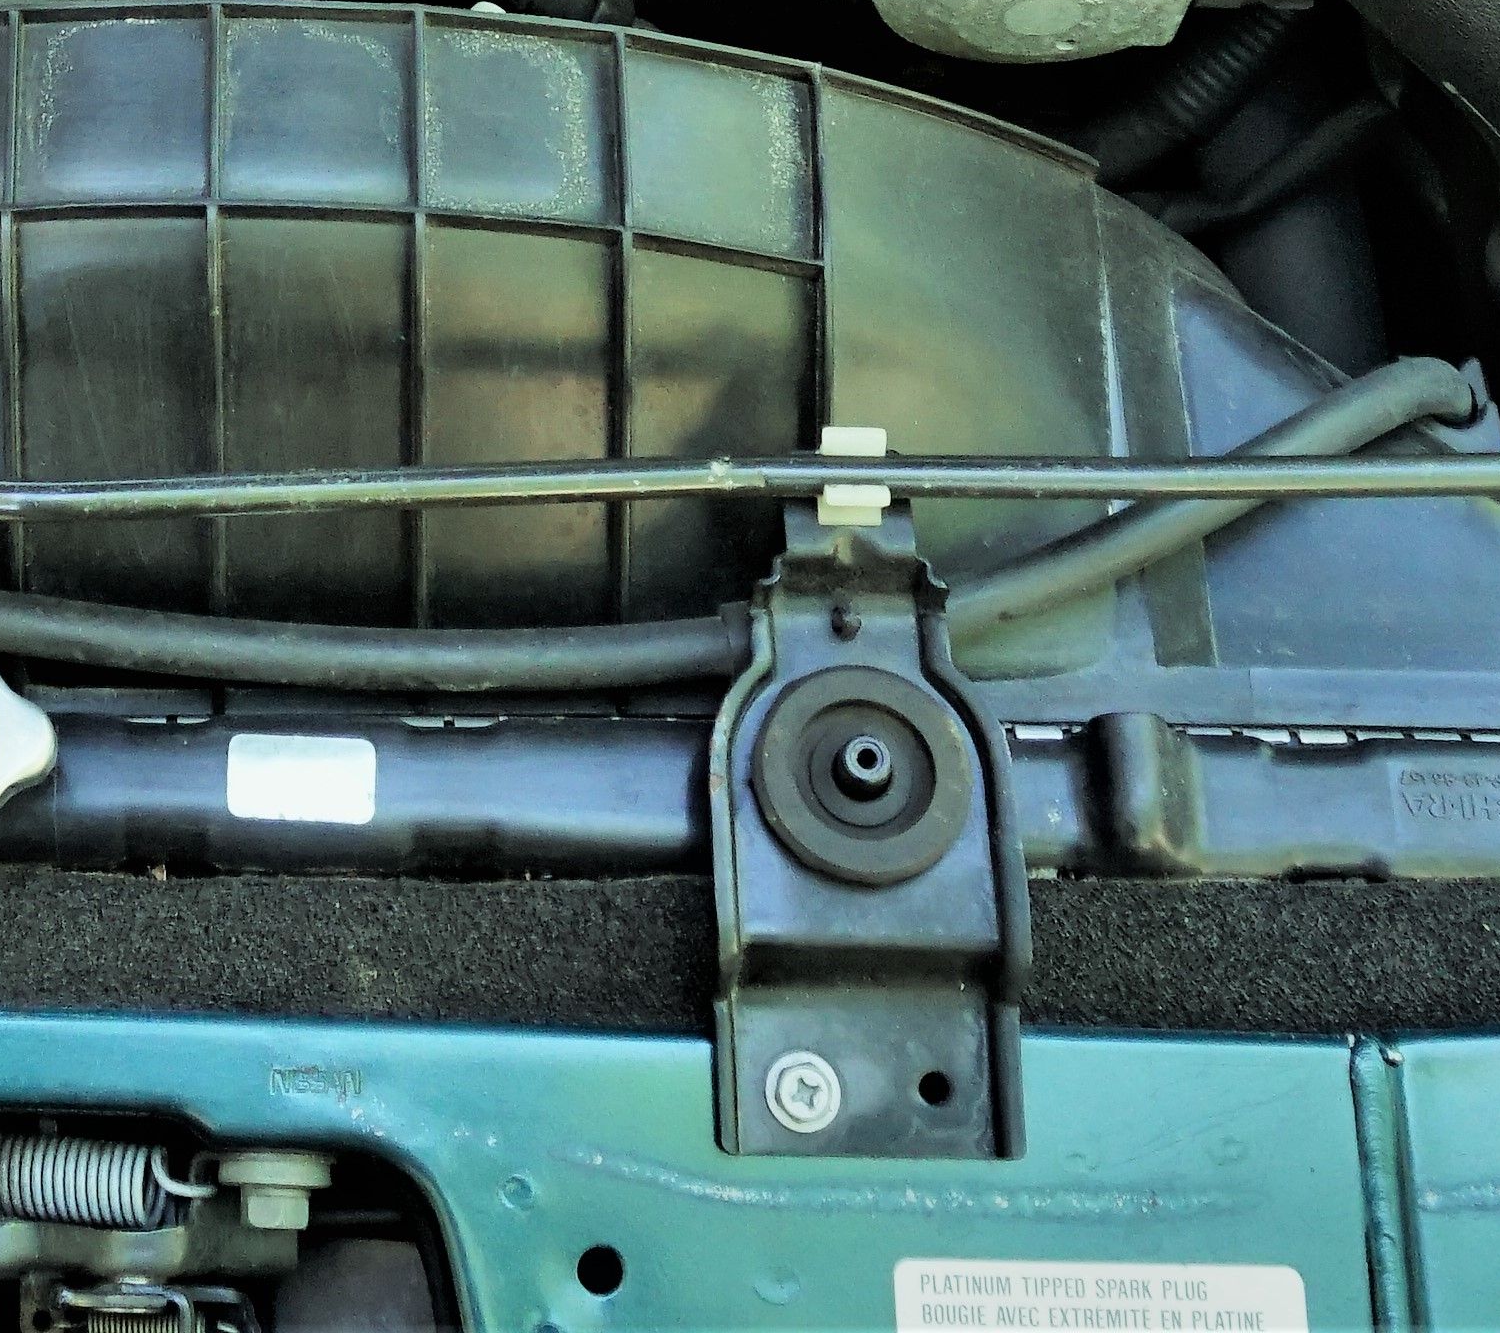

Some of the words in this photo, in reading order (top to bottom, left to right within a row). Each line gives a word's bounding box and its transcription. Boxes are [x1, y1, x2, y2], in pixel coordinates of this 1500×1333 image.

[920, 1273, 1012, 1297] PLATINUM
[1021, 1276, 1086, 1299] TIPPED
[1095, 1278, 1153, 1301] SPARK
[1162, 1279, 1208, 1302] PLUG
[921, 1303, 987, 1326] BOUGIE
[996, 1306, 1040, 1328] AVEC
[1160, 1309, 1183, 1331] EN
[1191, 1311, 1265, 1333] PLATINE
